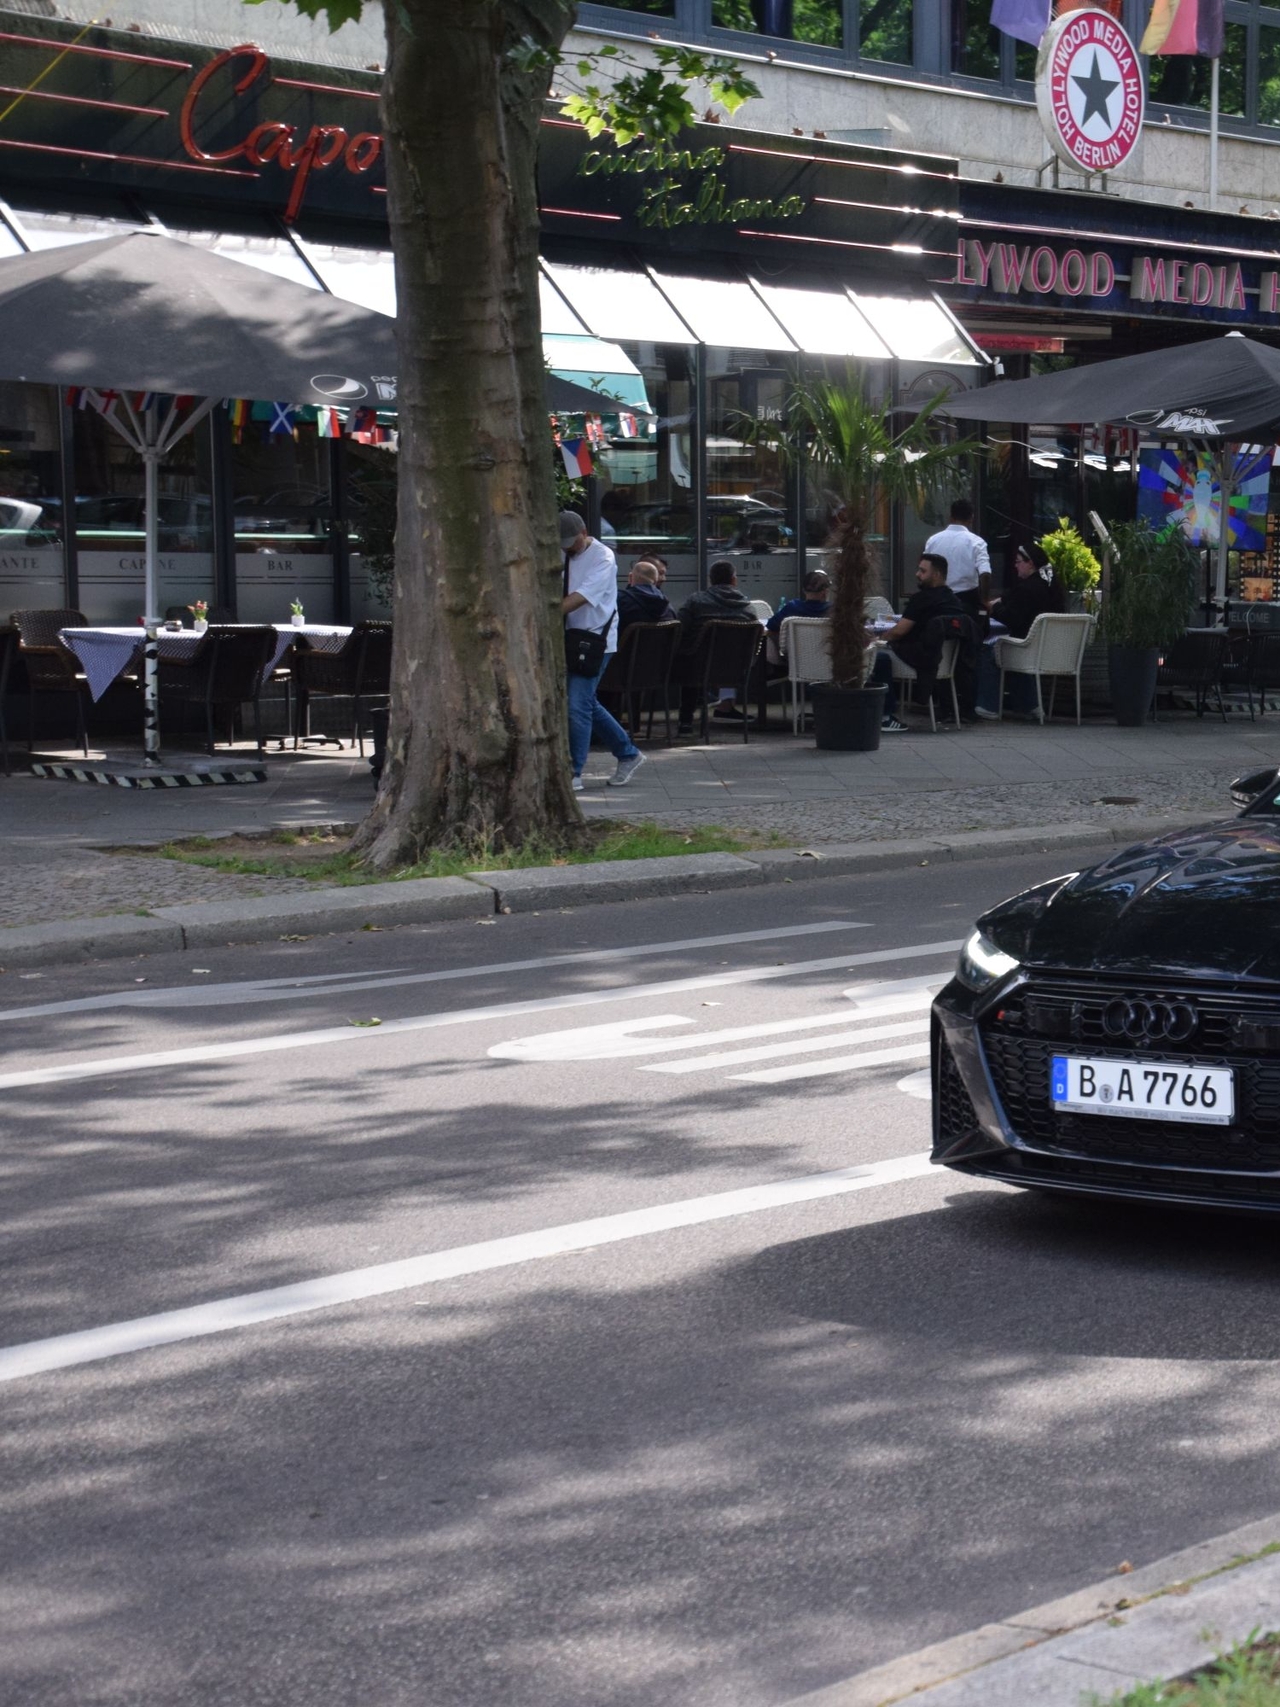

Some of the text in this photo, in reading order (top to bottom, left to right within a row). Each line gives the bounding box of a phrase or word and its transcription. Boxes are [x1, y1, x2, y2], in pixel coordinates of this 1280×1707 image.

[1053, 19, 1139, 167] HOLLYWOOD MEDIA HOTEL BERLIN
[945, 237, 1115, 297] LYWOOD
[1142, 256, 1247, 311] MEDIA
[1184, 407, 1208, 417] psi
[118, 558, 177, 571] CAPNE
[267, 560, 294, 572] BAR
[1056, 1083, 1065, 1095] D
[1079, 1064, 1218, 1109] B A 7766
